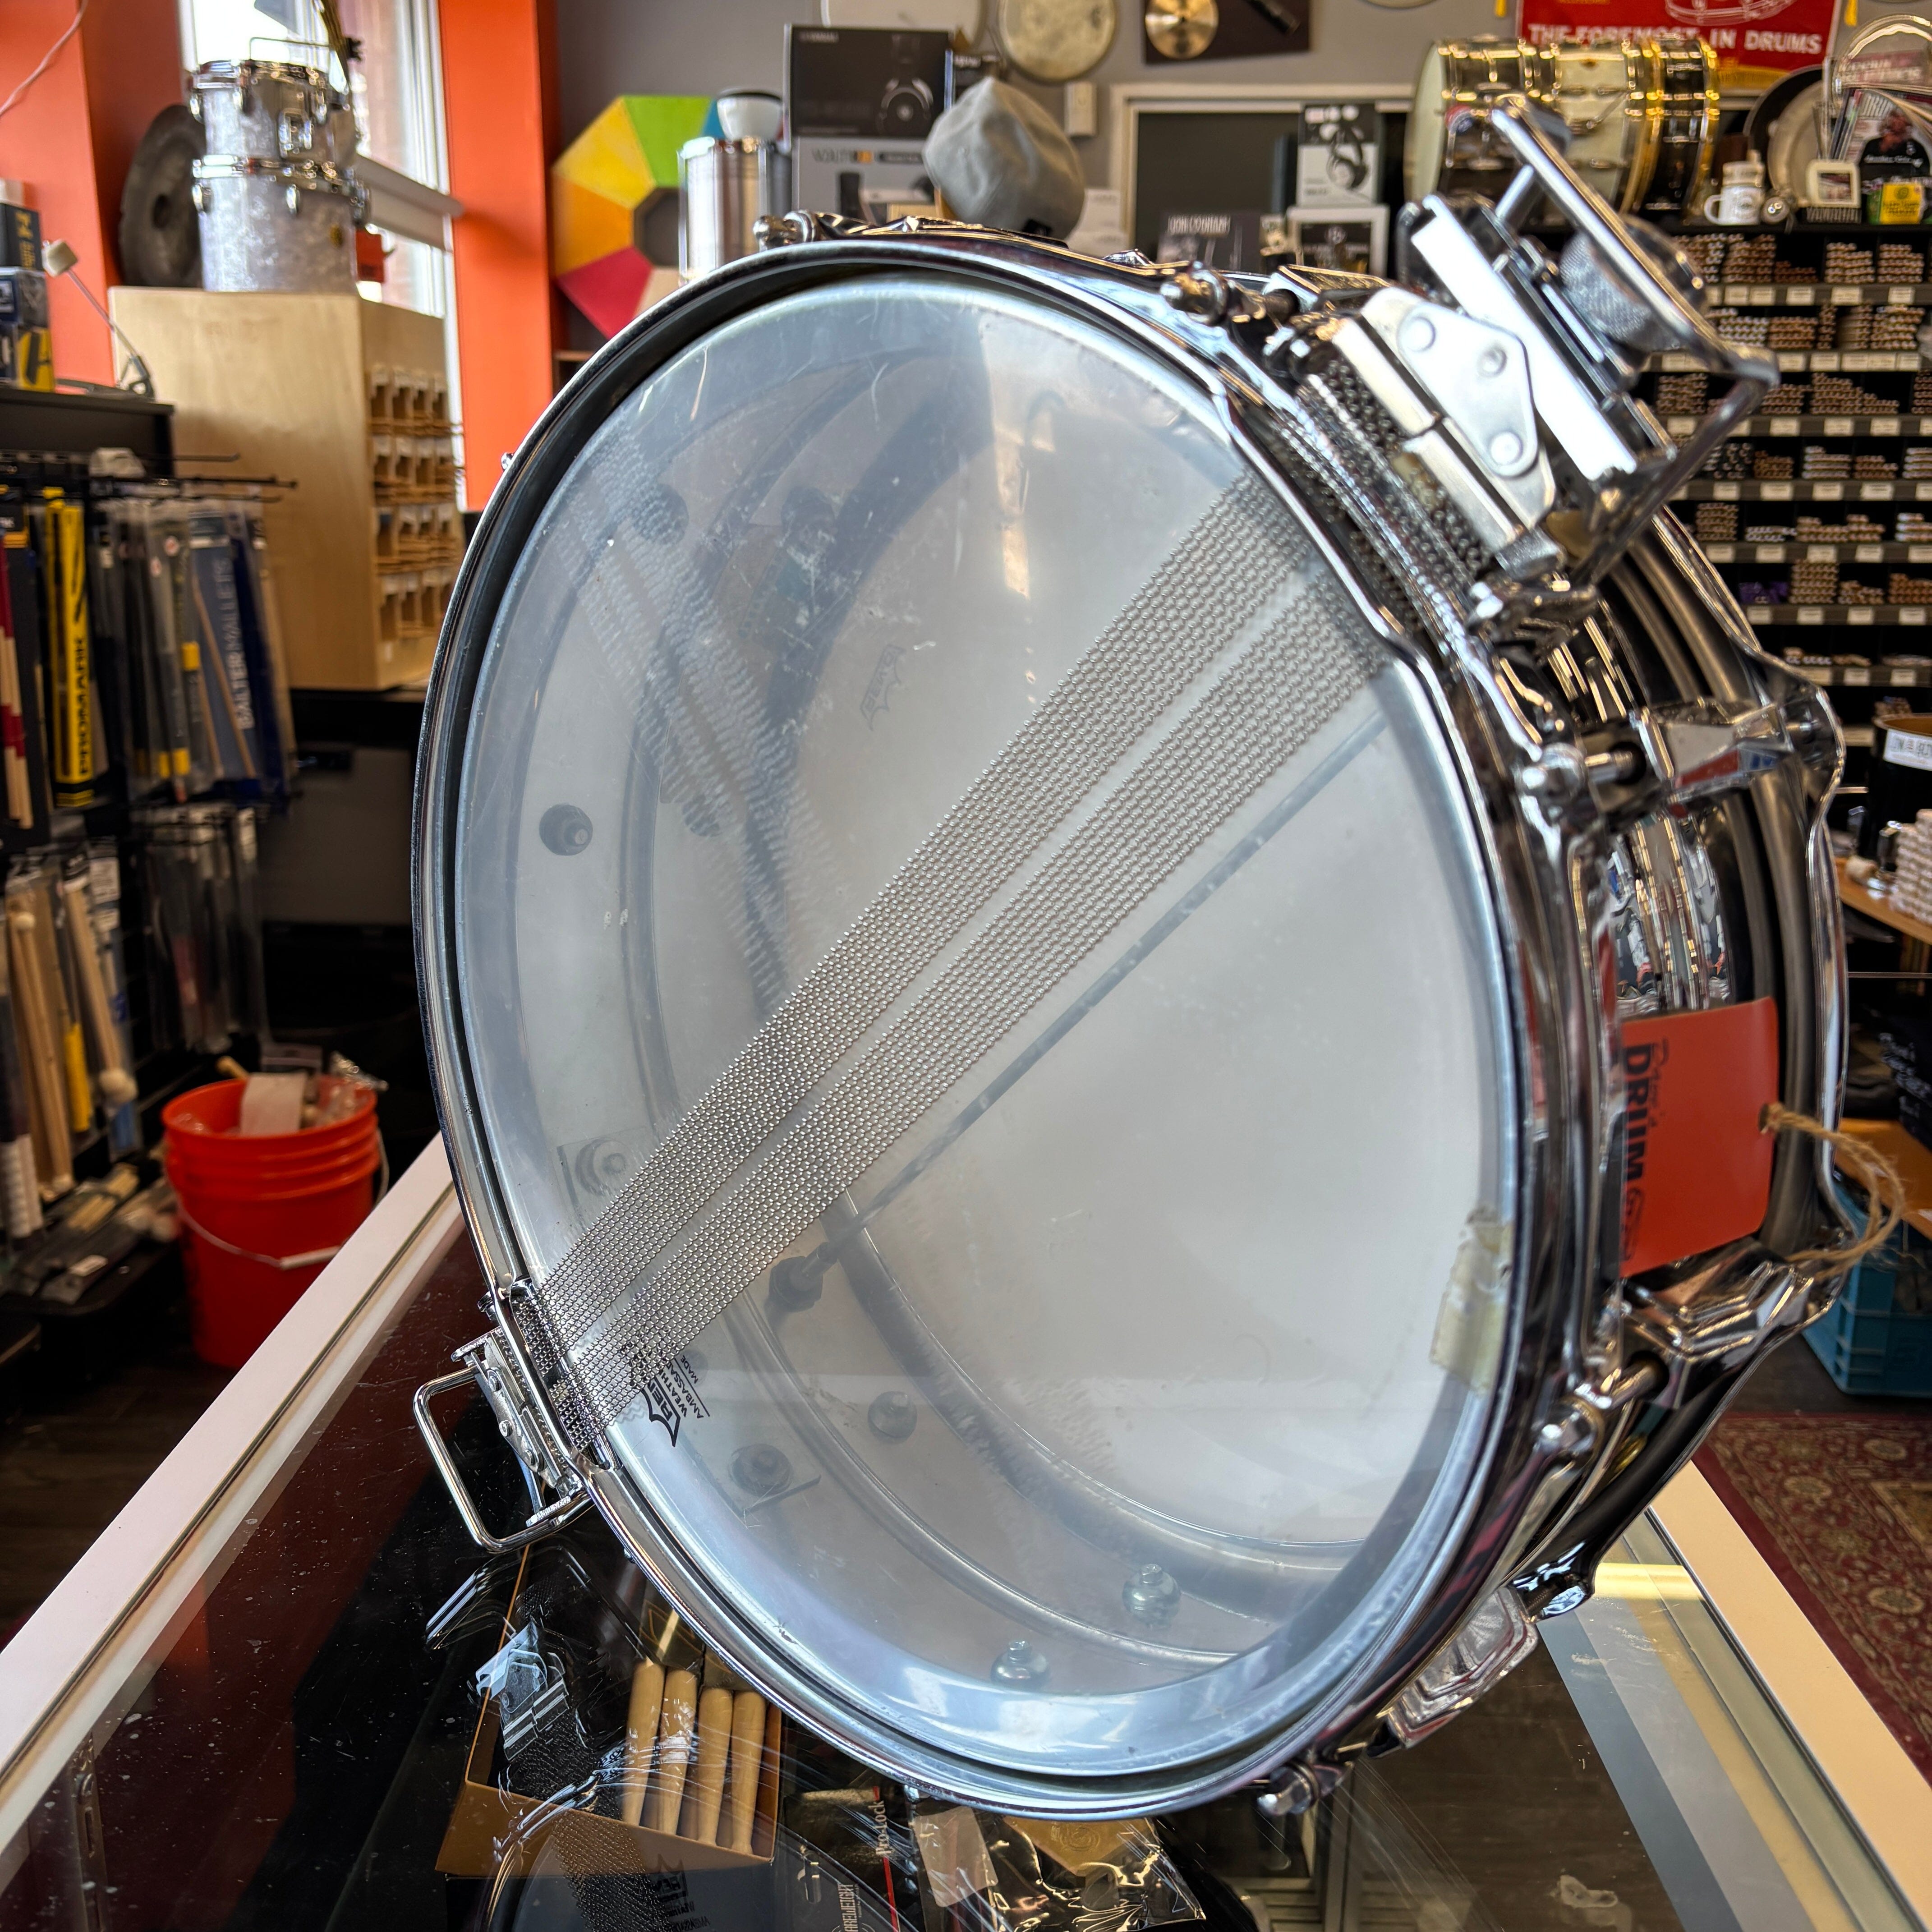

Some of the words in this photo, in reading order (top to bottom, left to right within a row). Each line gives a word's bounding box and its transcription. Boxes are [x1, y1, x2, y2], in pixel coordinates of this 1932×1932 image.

[1527, 23, 1572, 44] THE
[1710, 28, 1737, 49] IN
[1744, 30, 1822, 54] DRUMS
[1624, 1043, 1652, 1182] DRUM
[662, 1354, 704, 1419] AMBASSAD
[680, 1355, 699, 1384] MADE
[868, 1800, 892, 1855] Pro-Lock
